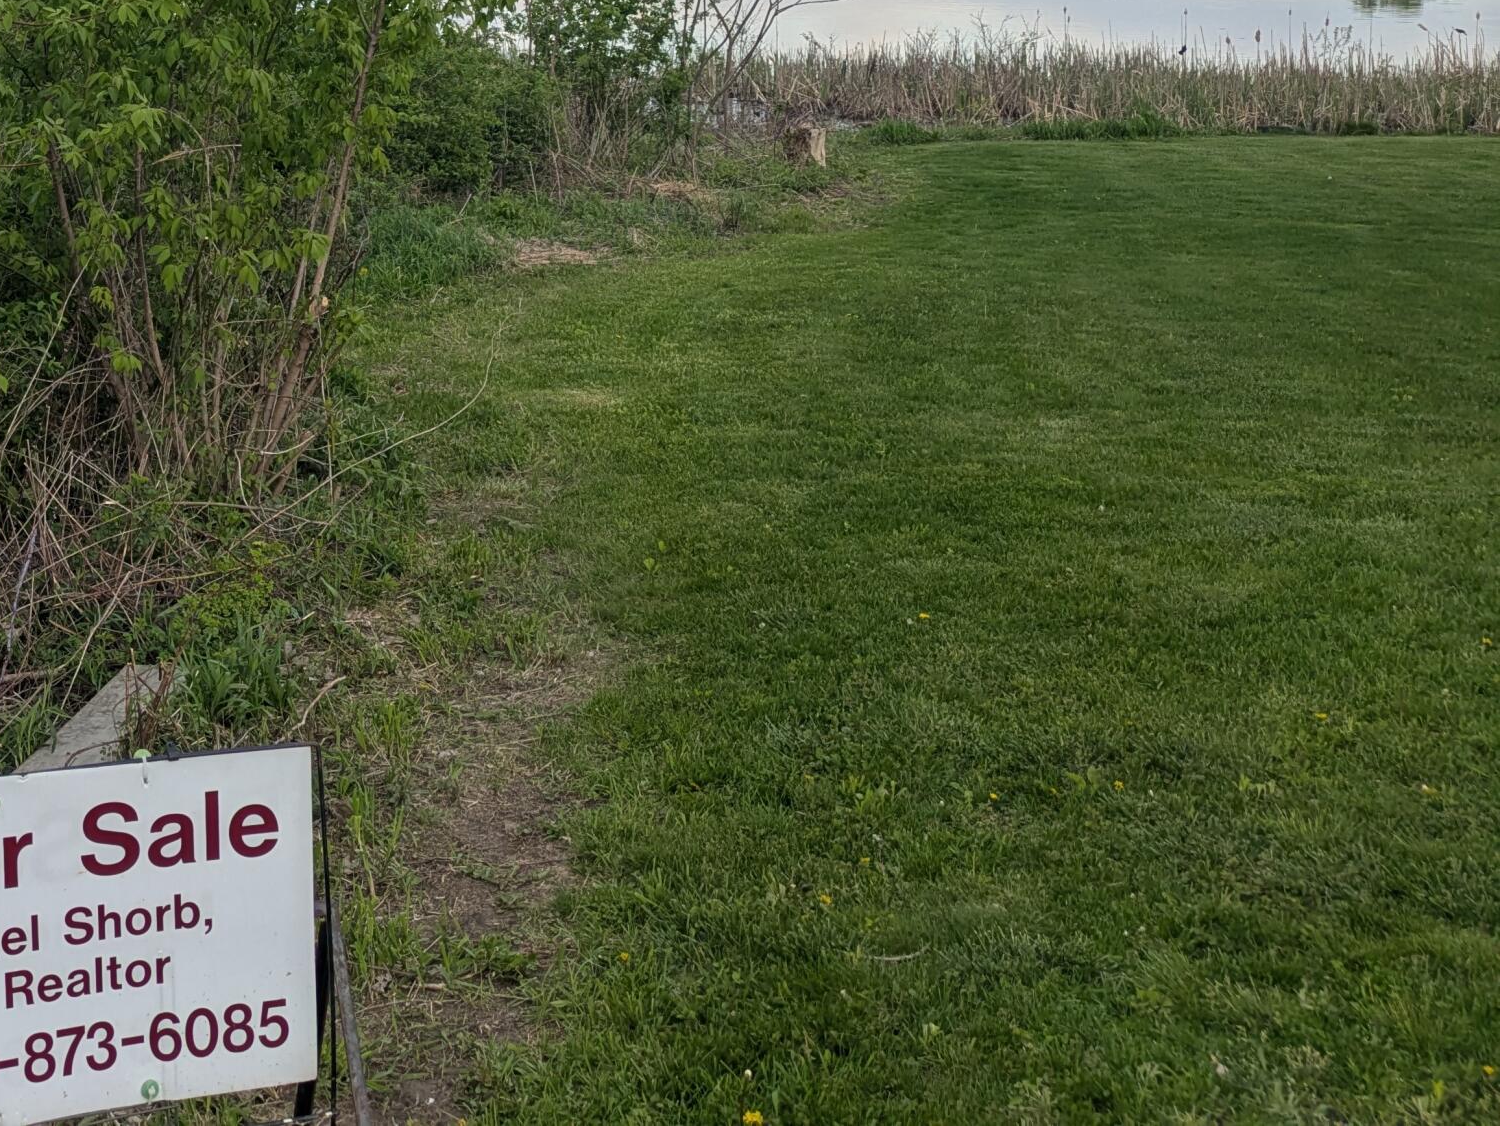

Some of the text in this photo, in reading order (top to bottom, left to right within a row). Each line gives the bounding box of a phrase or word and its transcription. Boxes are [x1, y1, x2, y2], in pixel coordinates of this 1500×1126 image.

[80, 790, 280, 876] Sale
[63, 894, 214, 946] Shorb,
[4, 956, 171, 1009] Realtor
